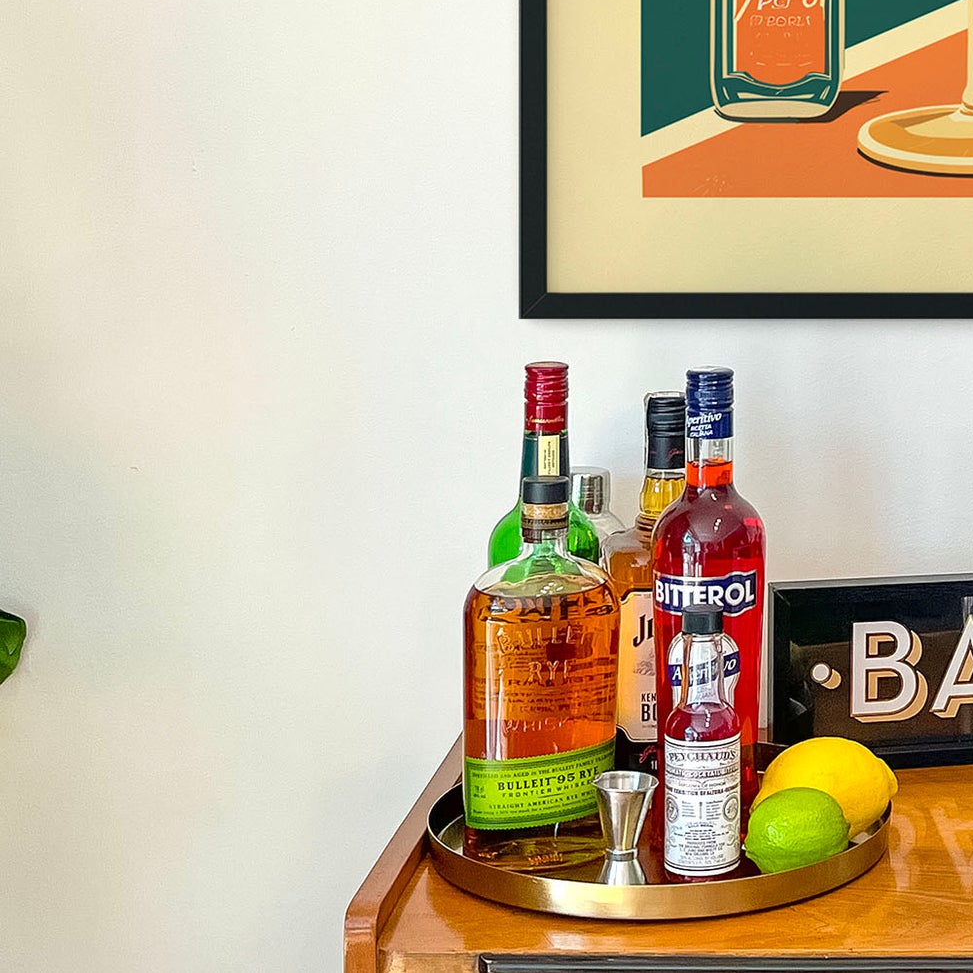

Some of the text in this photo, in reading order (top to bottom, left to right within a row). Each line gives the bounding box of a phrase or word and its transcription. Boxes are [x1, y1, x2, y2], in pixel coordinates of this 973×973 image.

[687, 411, 722, 427] peritivo
[655, 579, 755, 610] BITTEROL
[498, 765, 599, 791] BULLEIT 95 RYE
[502, 780, 593, 798] FRONTIER WHISKE
[527, 796, 564, 807] AMERICAN
